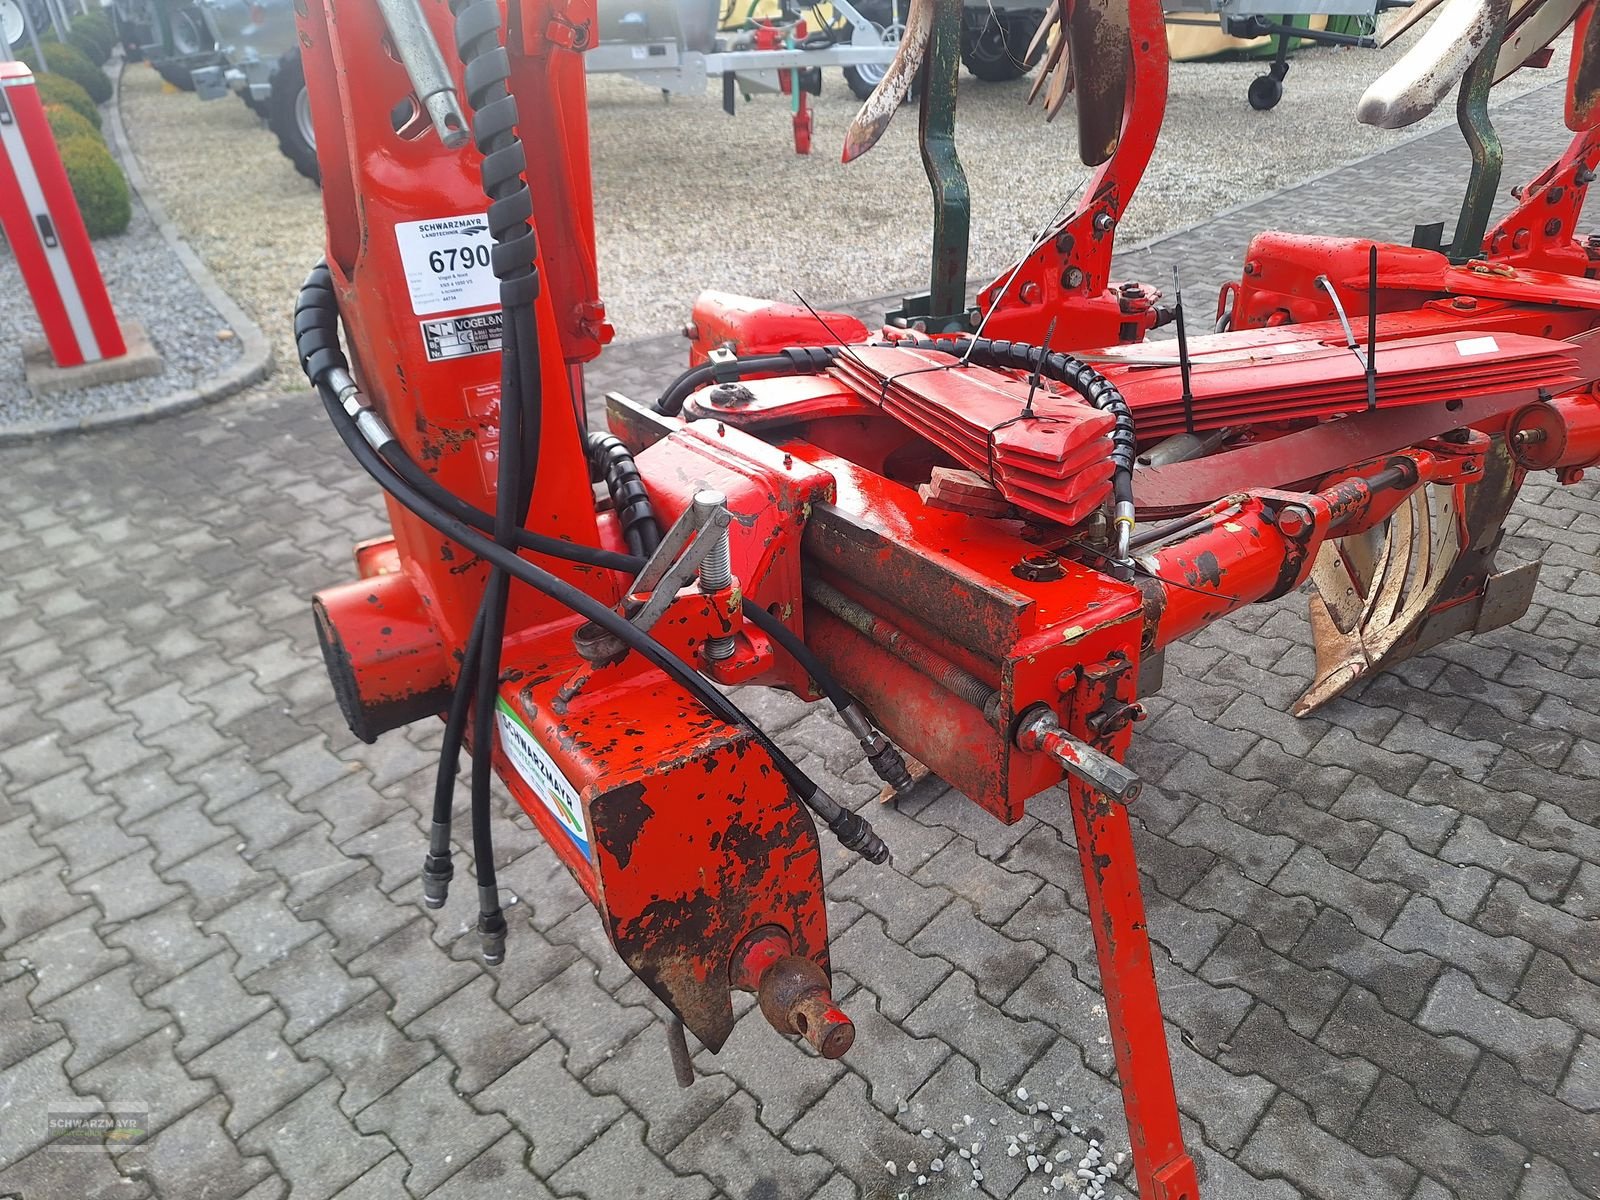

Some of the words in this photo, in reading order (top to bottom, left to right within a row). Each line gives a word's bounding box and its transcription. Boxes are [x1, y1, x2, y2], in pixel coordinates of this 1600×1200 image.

[418, 219, 481, 232] SCHWARZMAYR
[421, 230, 459, 238] LANDTECHNIK
[429, 245, 490, 273] 6790
[455, 315, 503, 330] VOGEL&N
[471, 344, 488, 352] Type
[502, 714, 574, 811] SCHWARZMAYR
